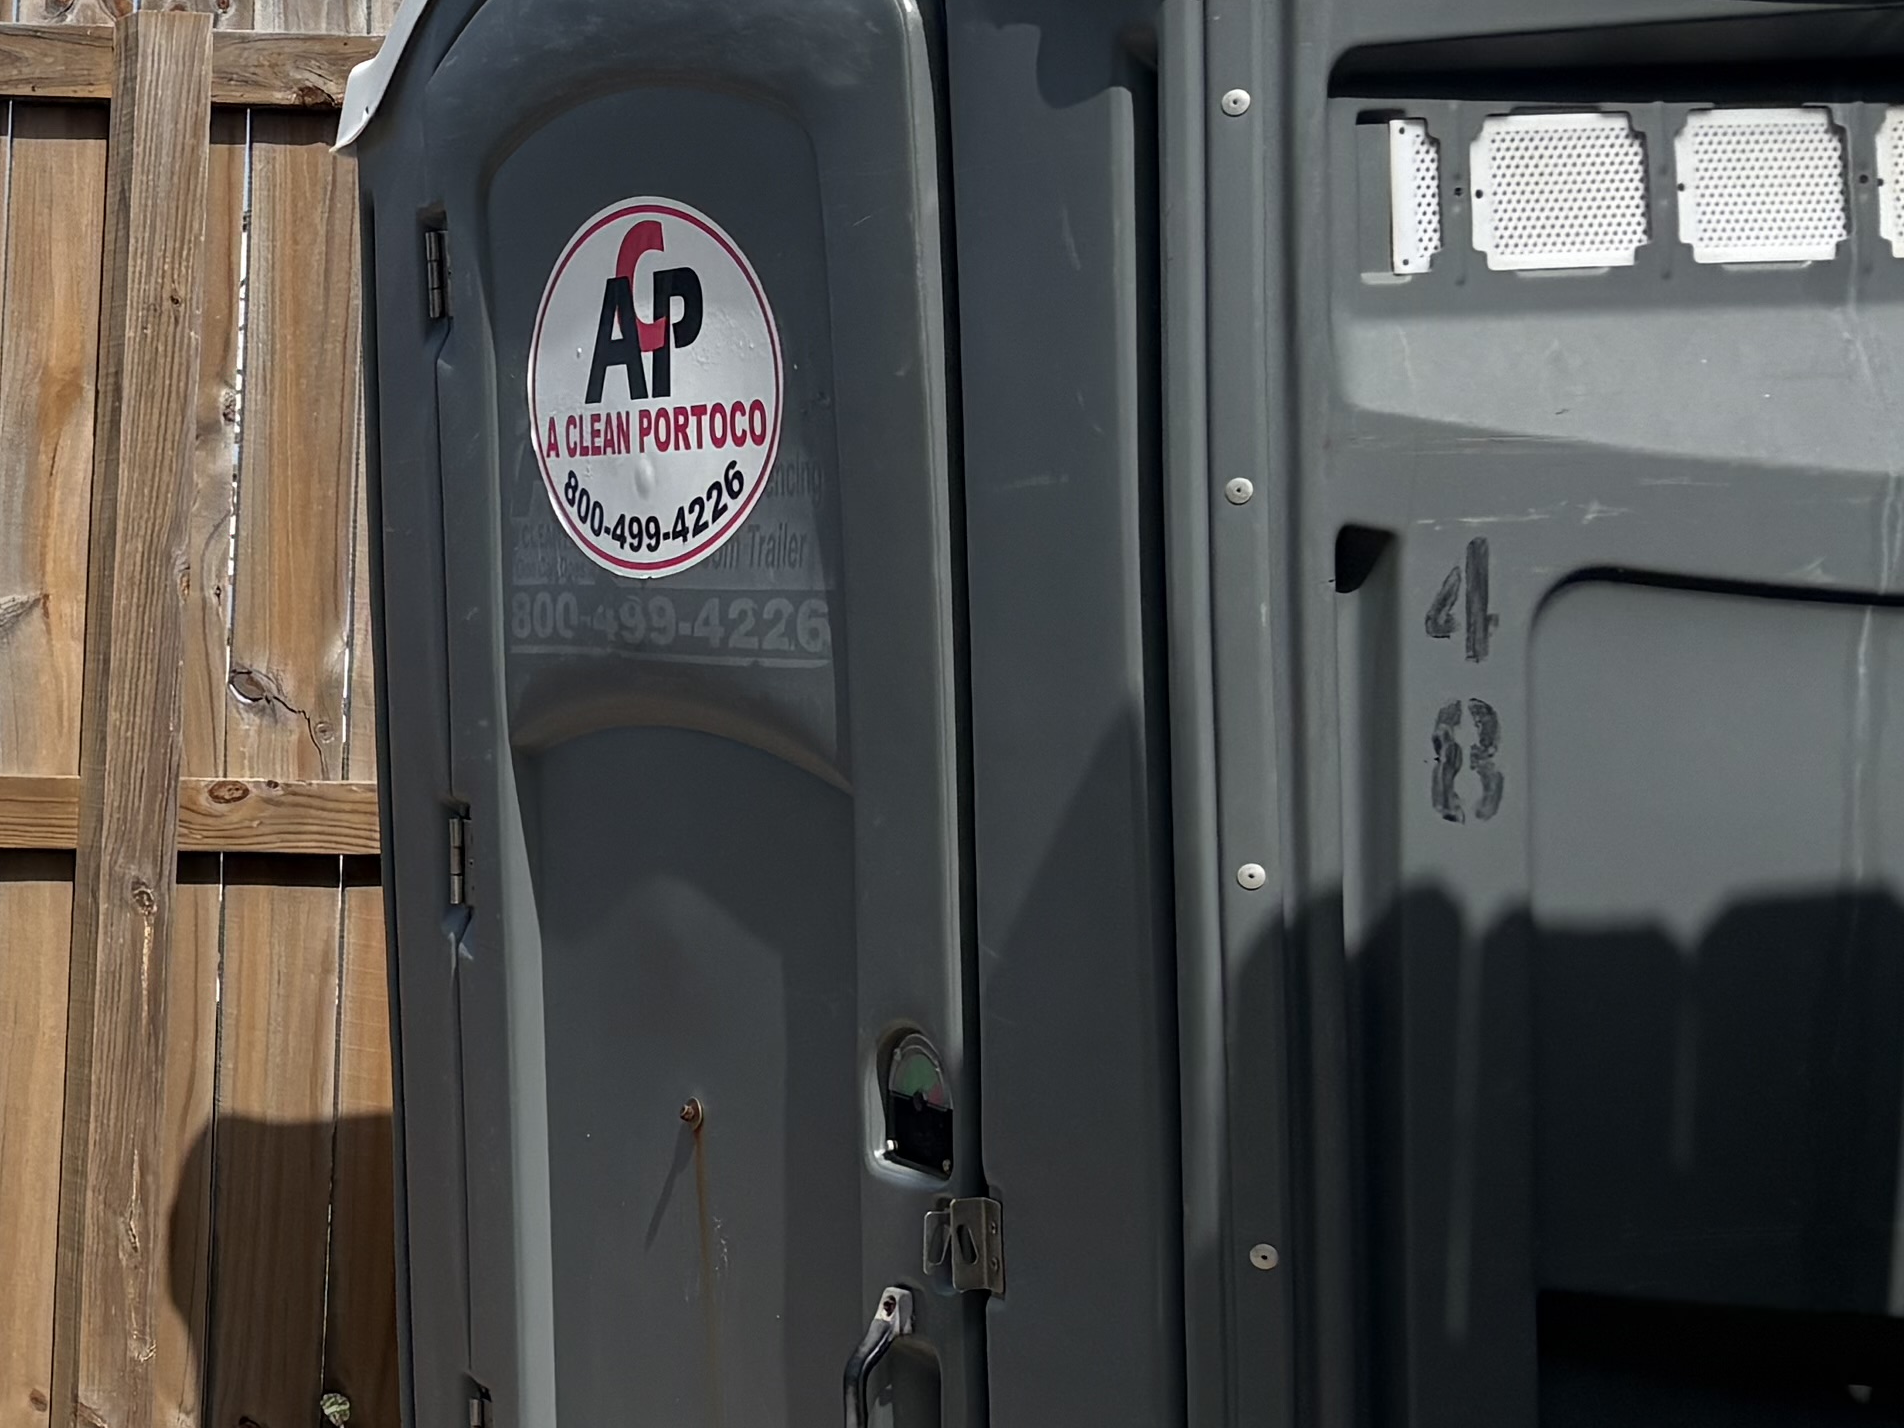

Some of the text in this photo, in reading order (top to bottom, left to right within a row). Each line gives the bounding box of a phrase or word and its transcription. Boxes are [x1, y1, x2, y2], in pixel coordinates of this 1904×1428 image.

[546, 398, 767, 459] A CLEAN PORTOCO
[564, 459, 745, 553] 800-499-4226
[747, 522, 807, 570] Trailer
